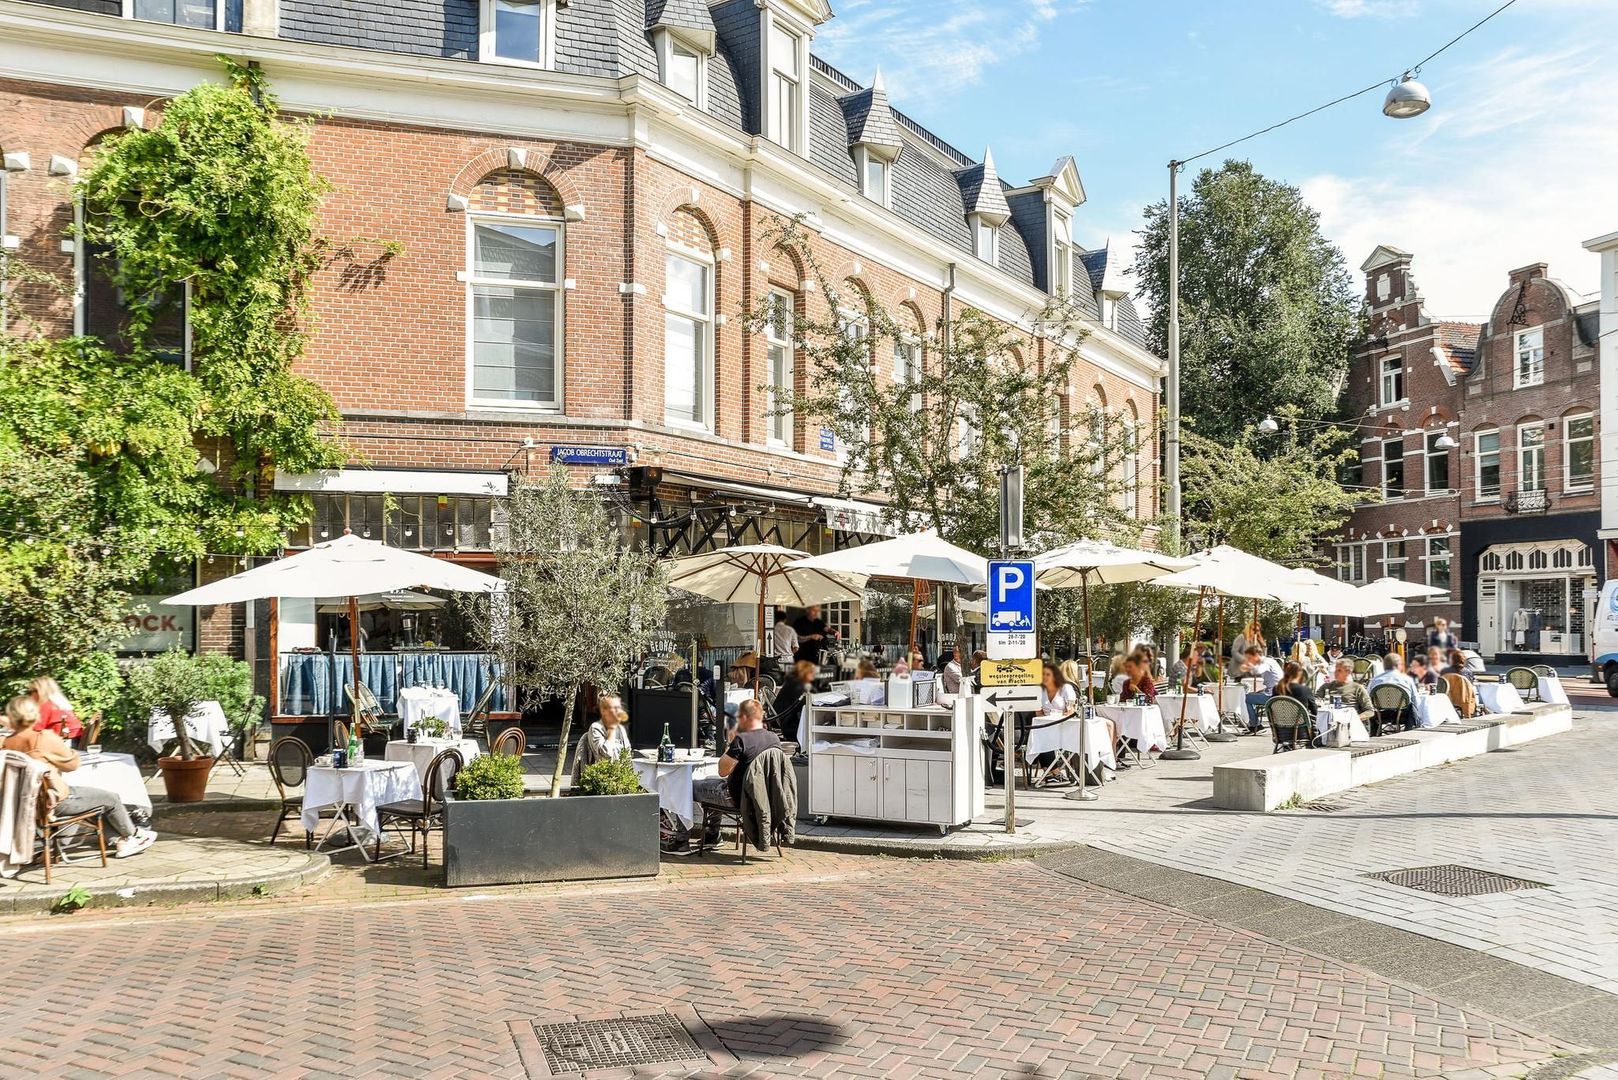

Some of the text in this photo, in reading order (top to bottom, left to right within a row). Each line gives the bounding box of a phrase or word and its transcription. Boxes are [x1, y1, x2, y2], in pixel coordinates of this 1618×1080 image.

[576, 449, 623, 458] OBRECHTSTRAAT
[999, 566, 1024, 602] P
[650, 640, 678, 654] GEORGE
